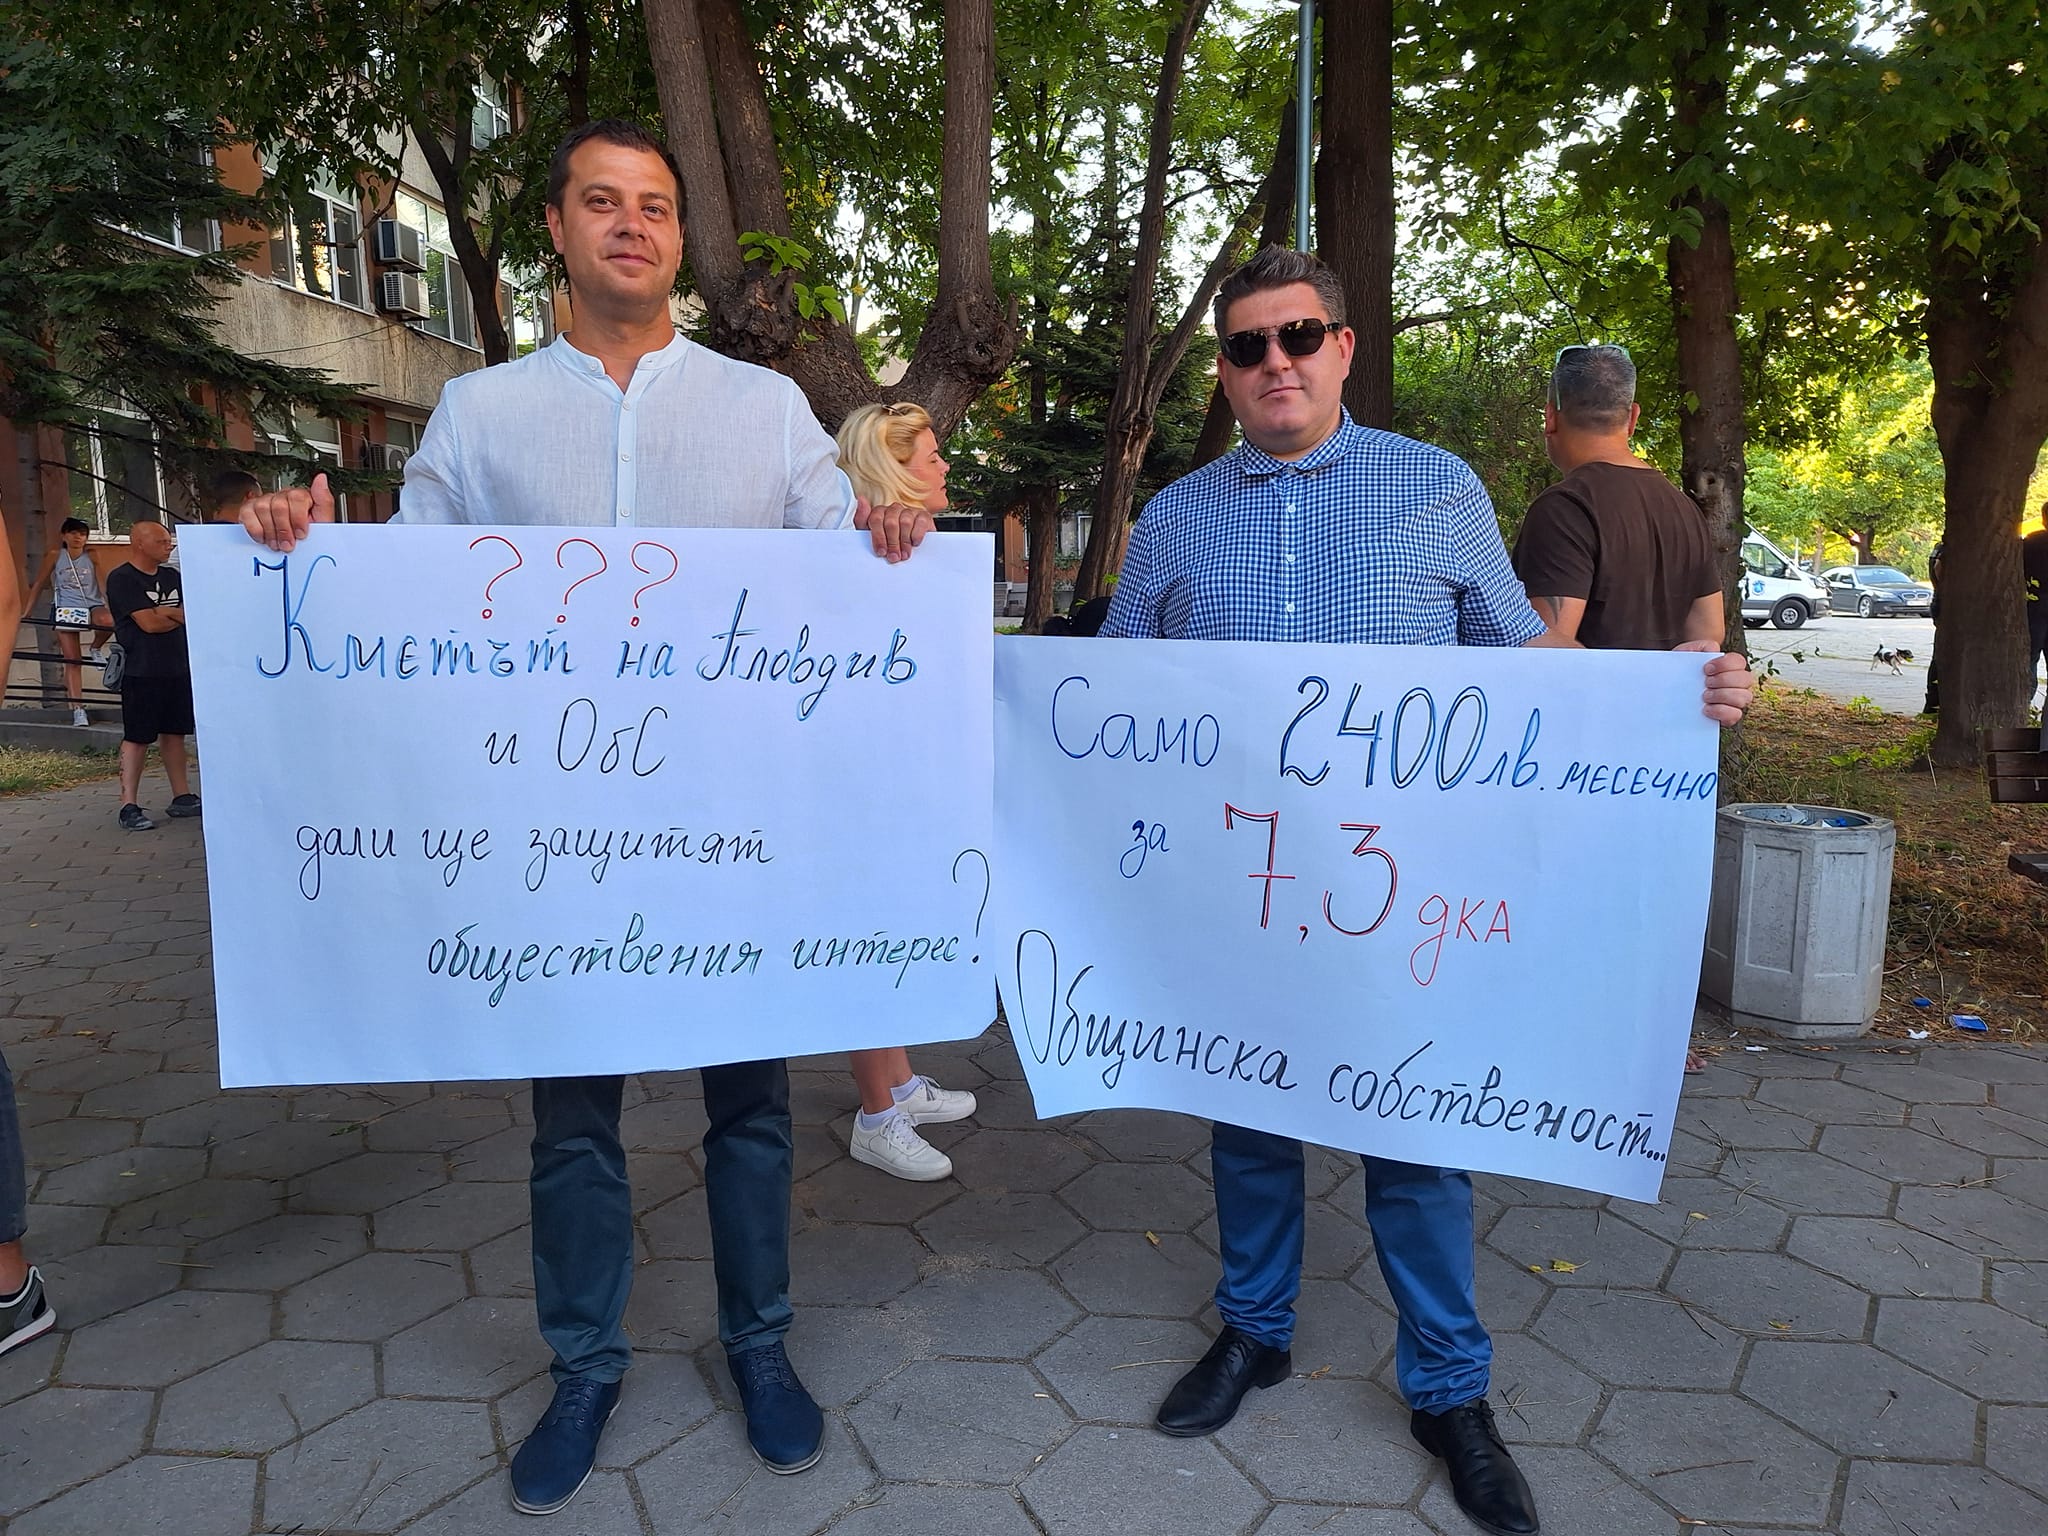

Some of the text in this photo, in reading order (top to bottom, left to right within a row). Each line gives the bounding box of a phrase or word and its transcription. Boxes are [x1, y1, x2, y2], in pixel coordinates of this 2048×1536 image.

[616, 637, 678, 680] на
[696, 587, 919, 722] Пловдив
[484, 697, 670, 778] и ОбС
[1051, 675, 1221, 768] Само
[296, 823, 775, 901] дали ще защитят
[1119, 818, 1172, 879] за
[1224, 802, 1398, 947] 7,3
[427, 911, 764, 1007] обществения
[1016, 928, 1299, 1091] Общинска
